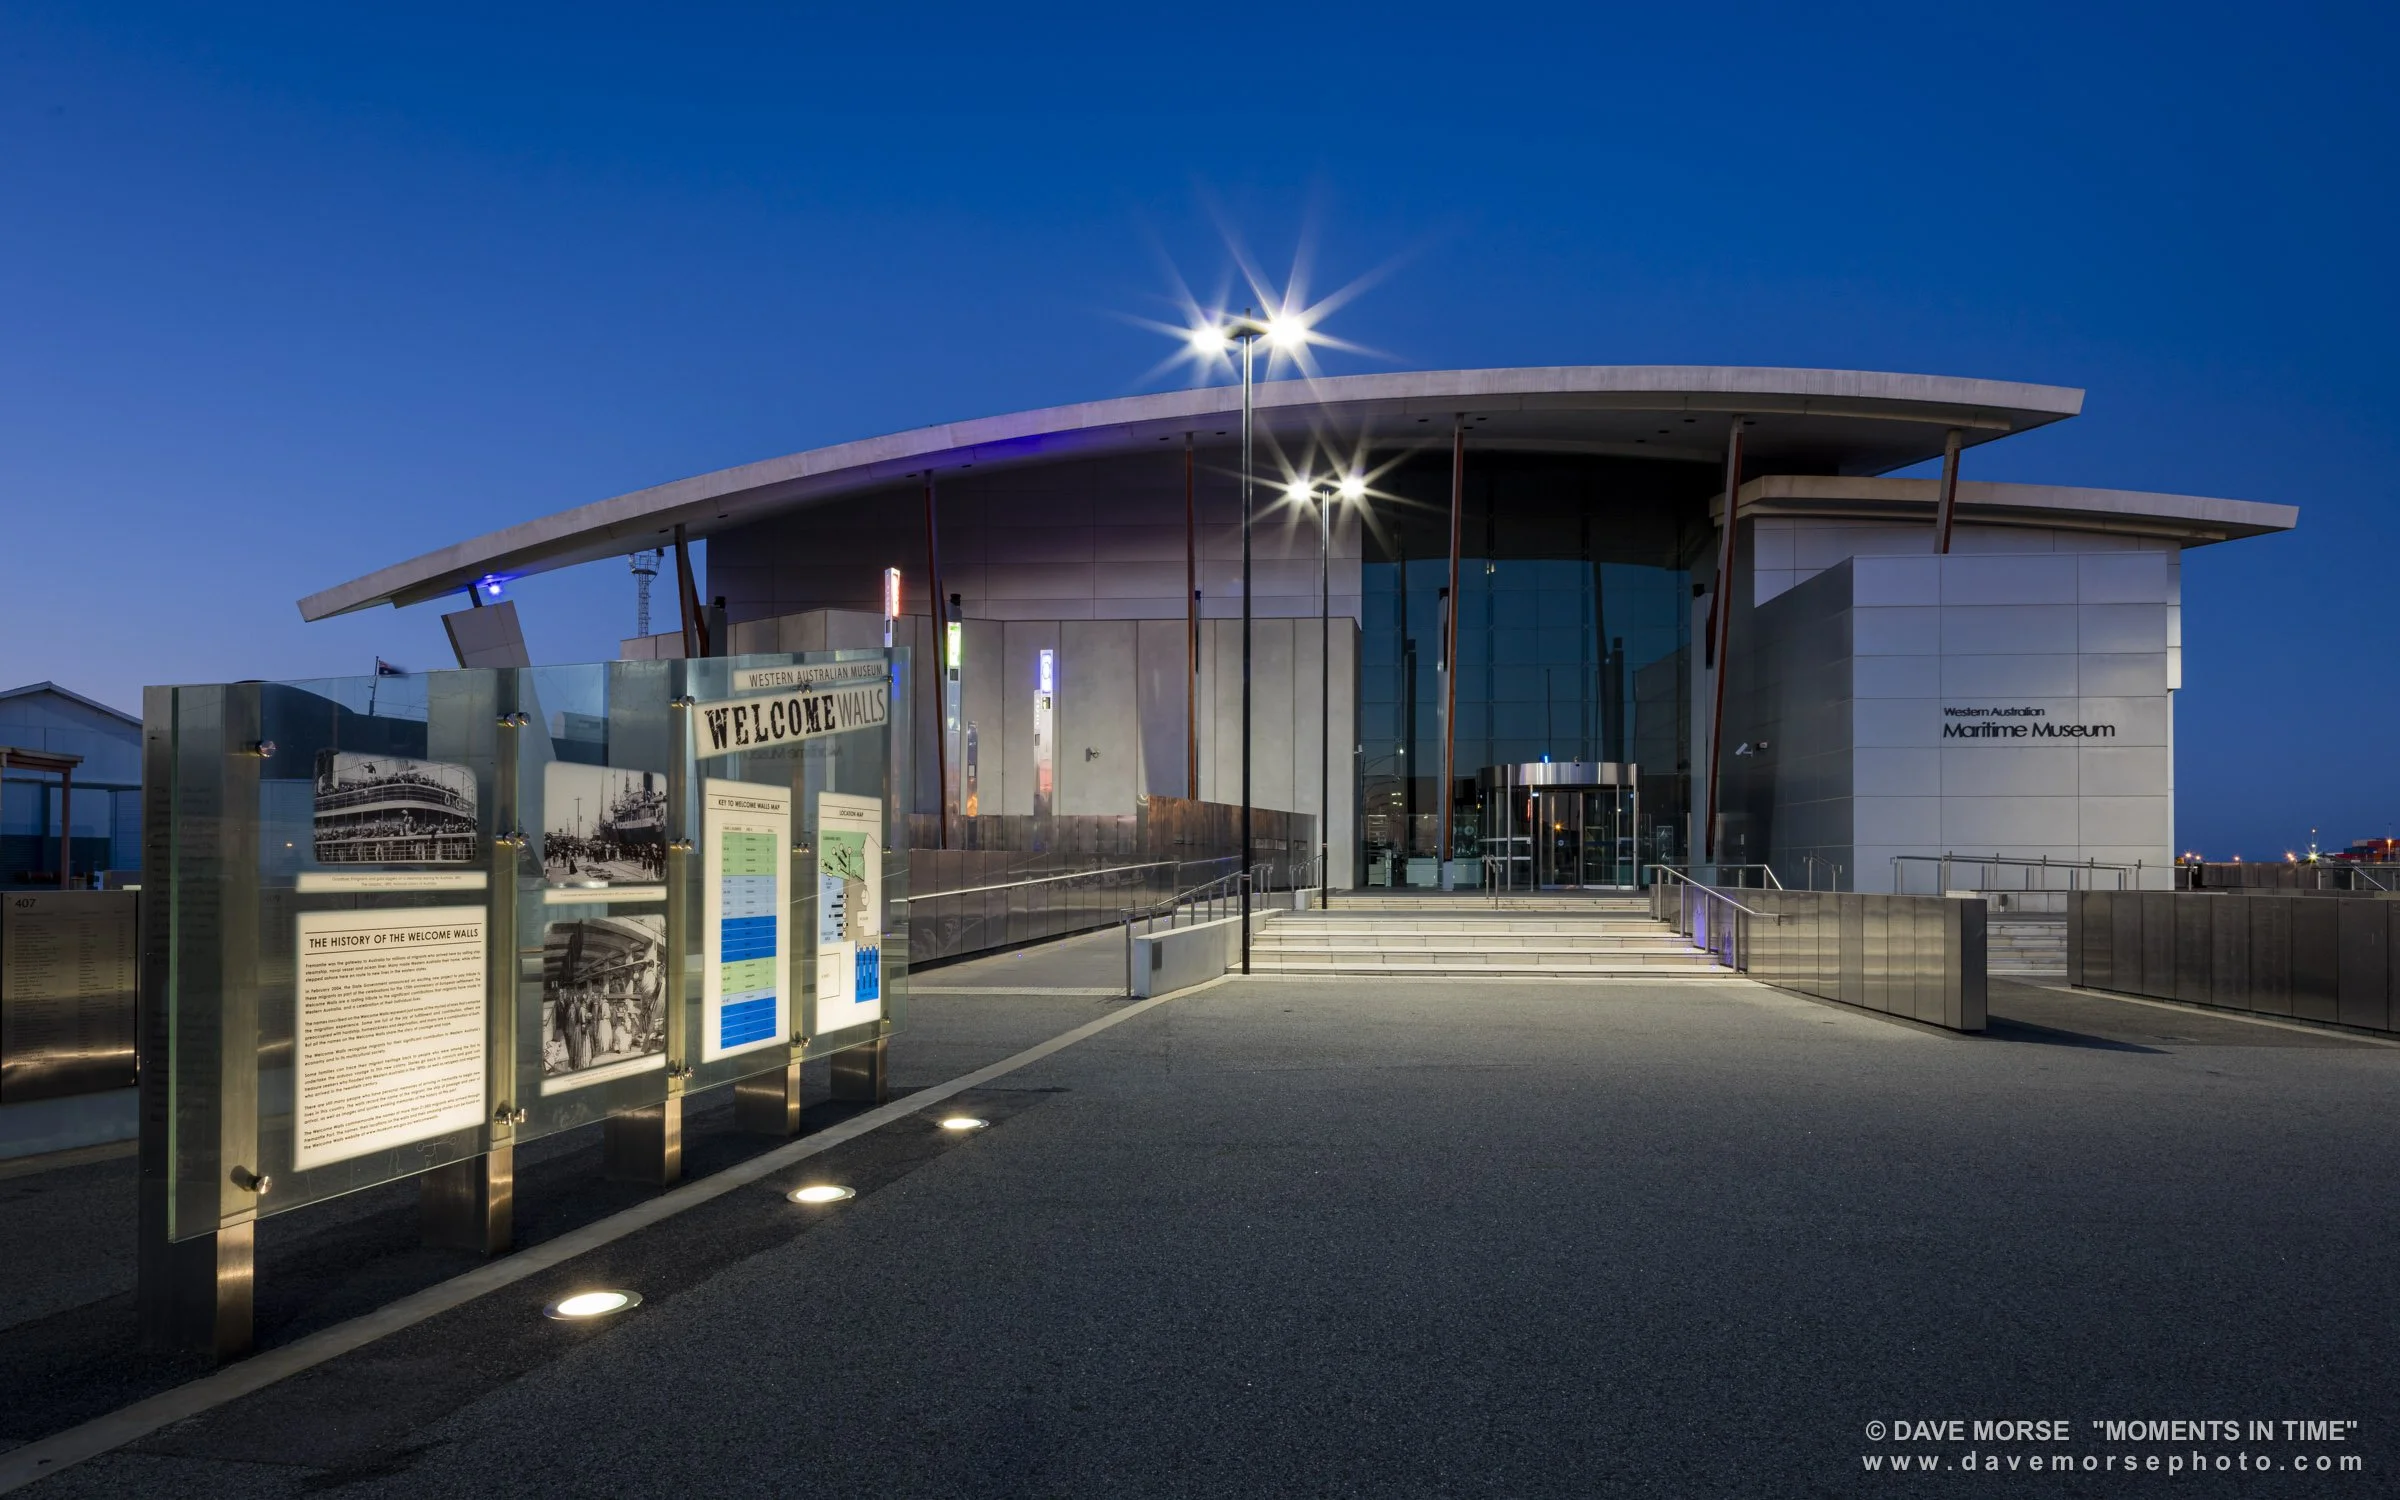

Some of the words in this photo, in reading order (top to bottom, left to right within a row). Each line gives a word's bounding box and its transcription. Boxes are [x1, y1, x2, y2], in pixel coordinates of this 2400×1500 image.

[749, 673, 793, 687] WESTERN
[797, 668, 848, 683] AUSTRALIAN
[851, 664, 882, 677] MUSEUM
[705, 694, 836, 750] WELCOME
[837, 689, 886, 727] WALLS
[1944, 708, 1990, 717] Western
[1991, 707, 2045, 717] Australian
[1943, 721, 2027, 738] Maritime
[2032, 722, 2115, 738] Museum
[735, 800, 757, 809] WELCOME
[15, 898, 36, 909] 407
[310, 937, 327, 948] THE
[331, 935, 370, 947] HISTORY
[374, 933, 387, 944] OF
[390, 932, 405, 943] THE
[408, 930, 451, 941] WELCOME
[454, 928, 479, 938] WALLS
